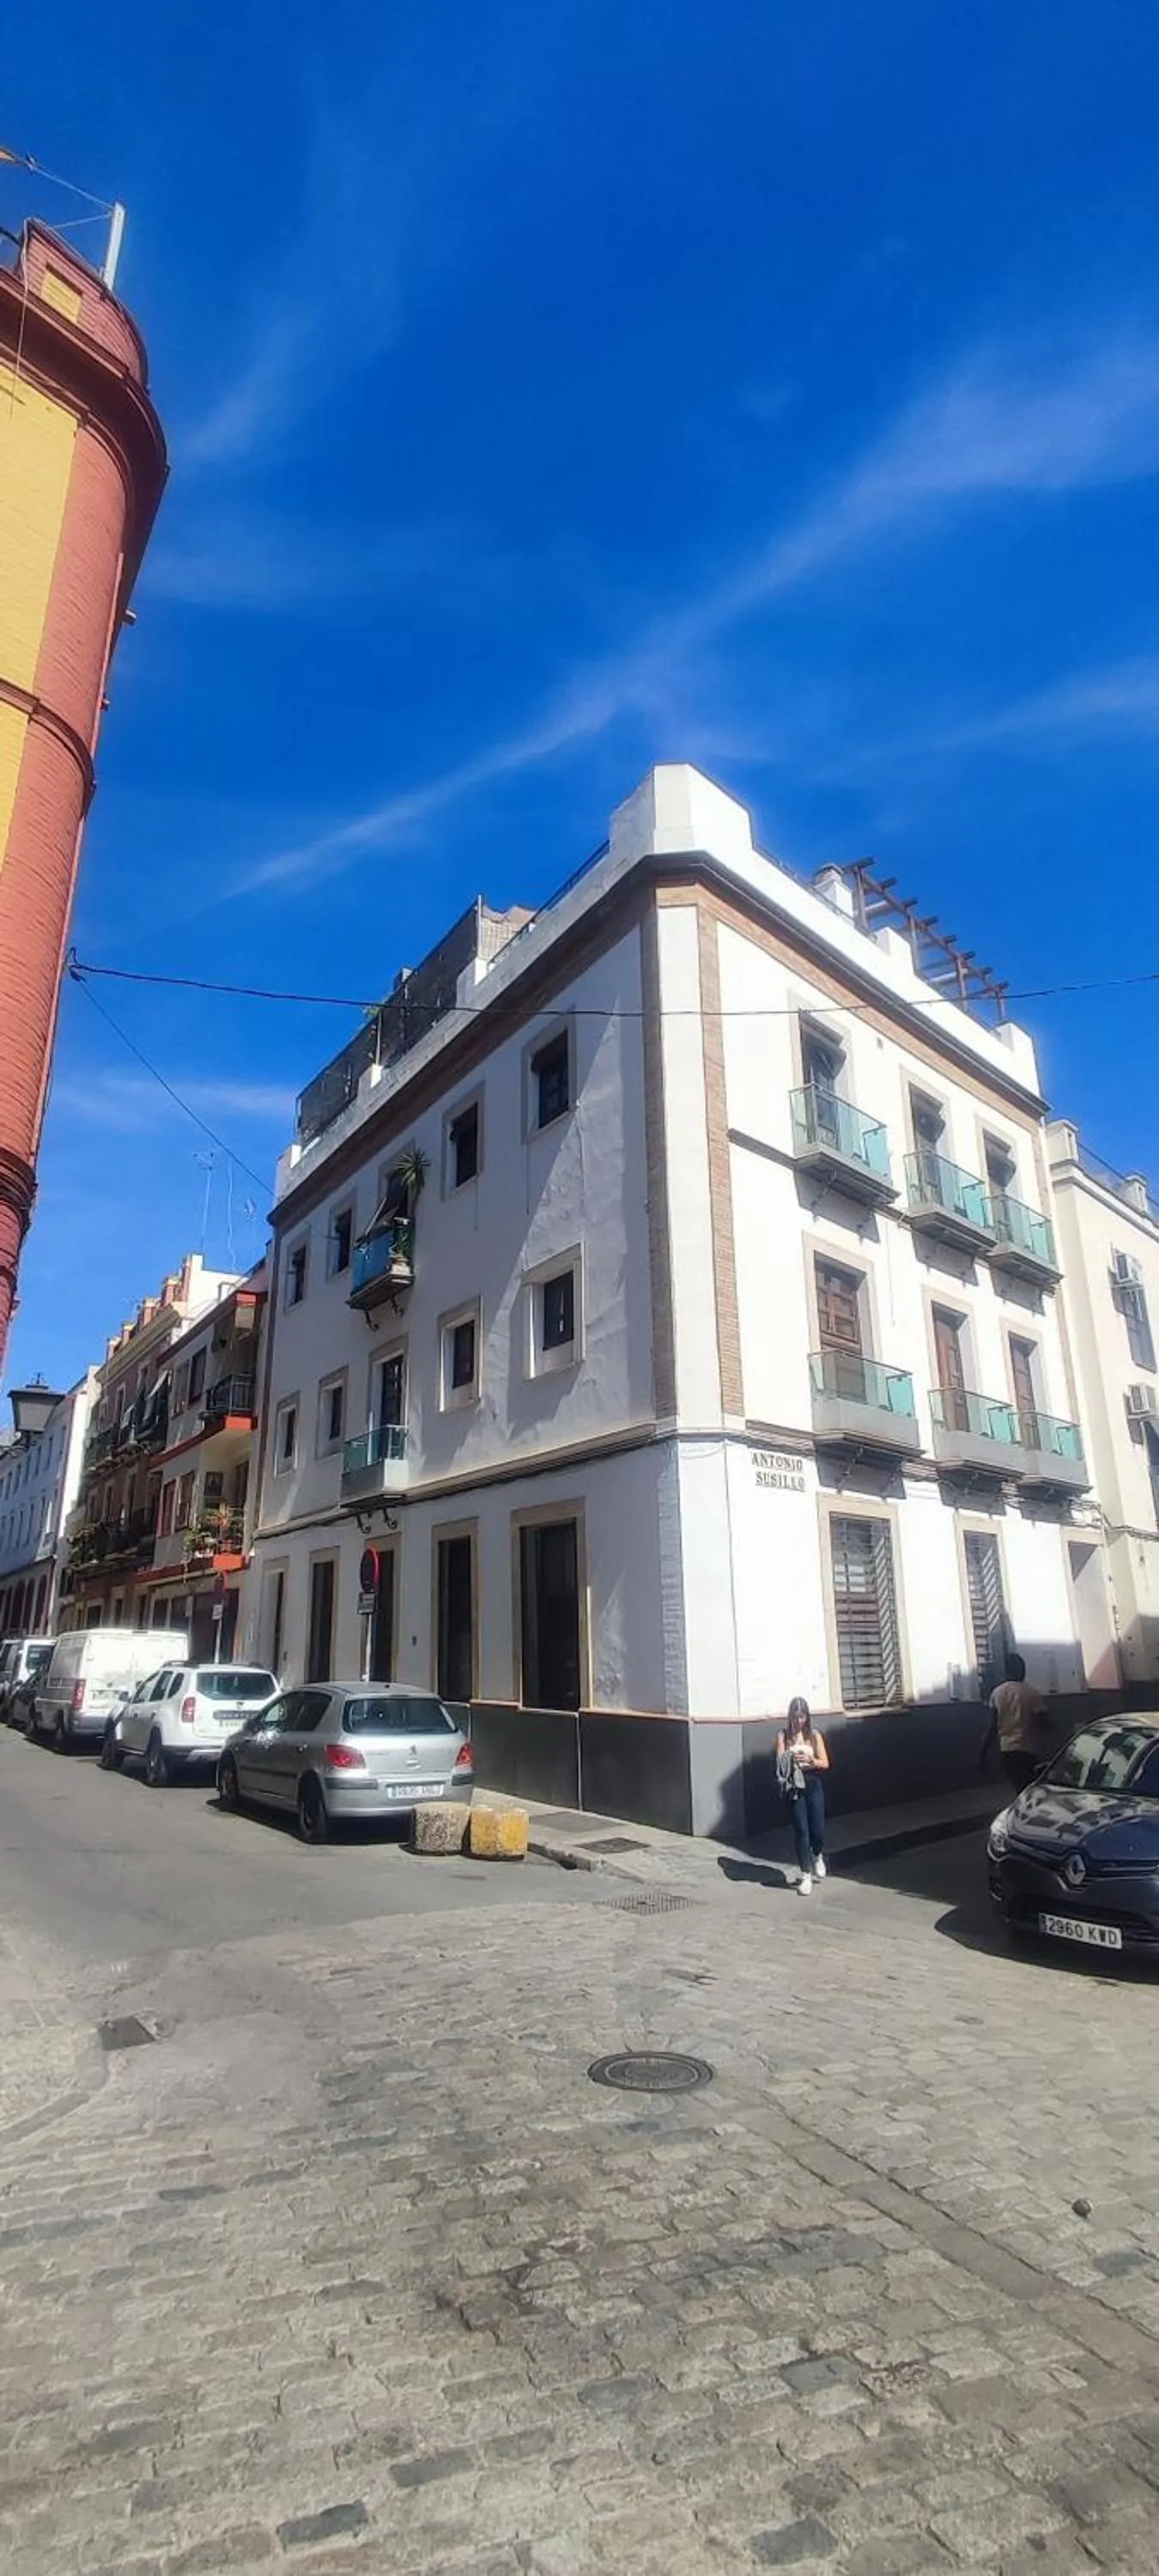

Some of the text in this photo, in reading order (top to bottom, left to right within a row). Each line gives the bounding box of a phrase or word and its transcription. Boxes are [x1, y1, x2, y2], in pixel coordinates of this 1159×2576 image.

[751, 1452, 803, 1471] ANTONIO
[755, 1471, 805, 1492] SUSILLO
[1047, 1917, 1083, 1938] 2960
